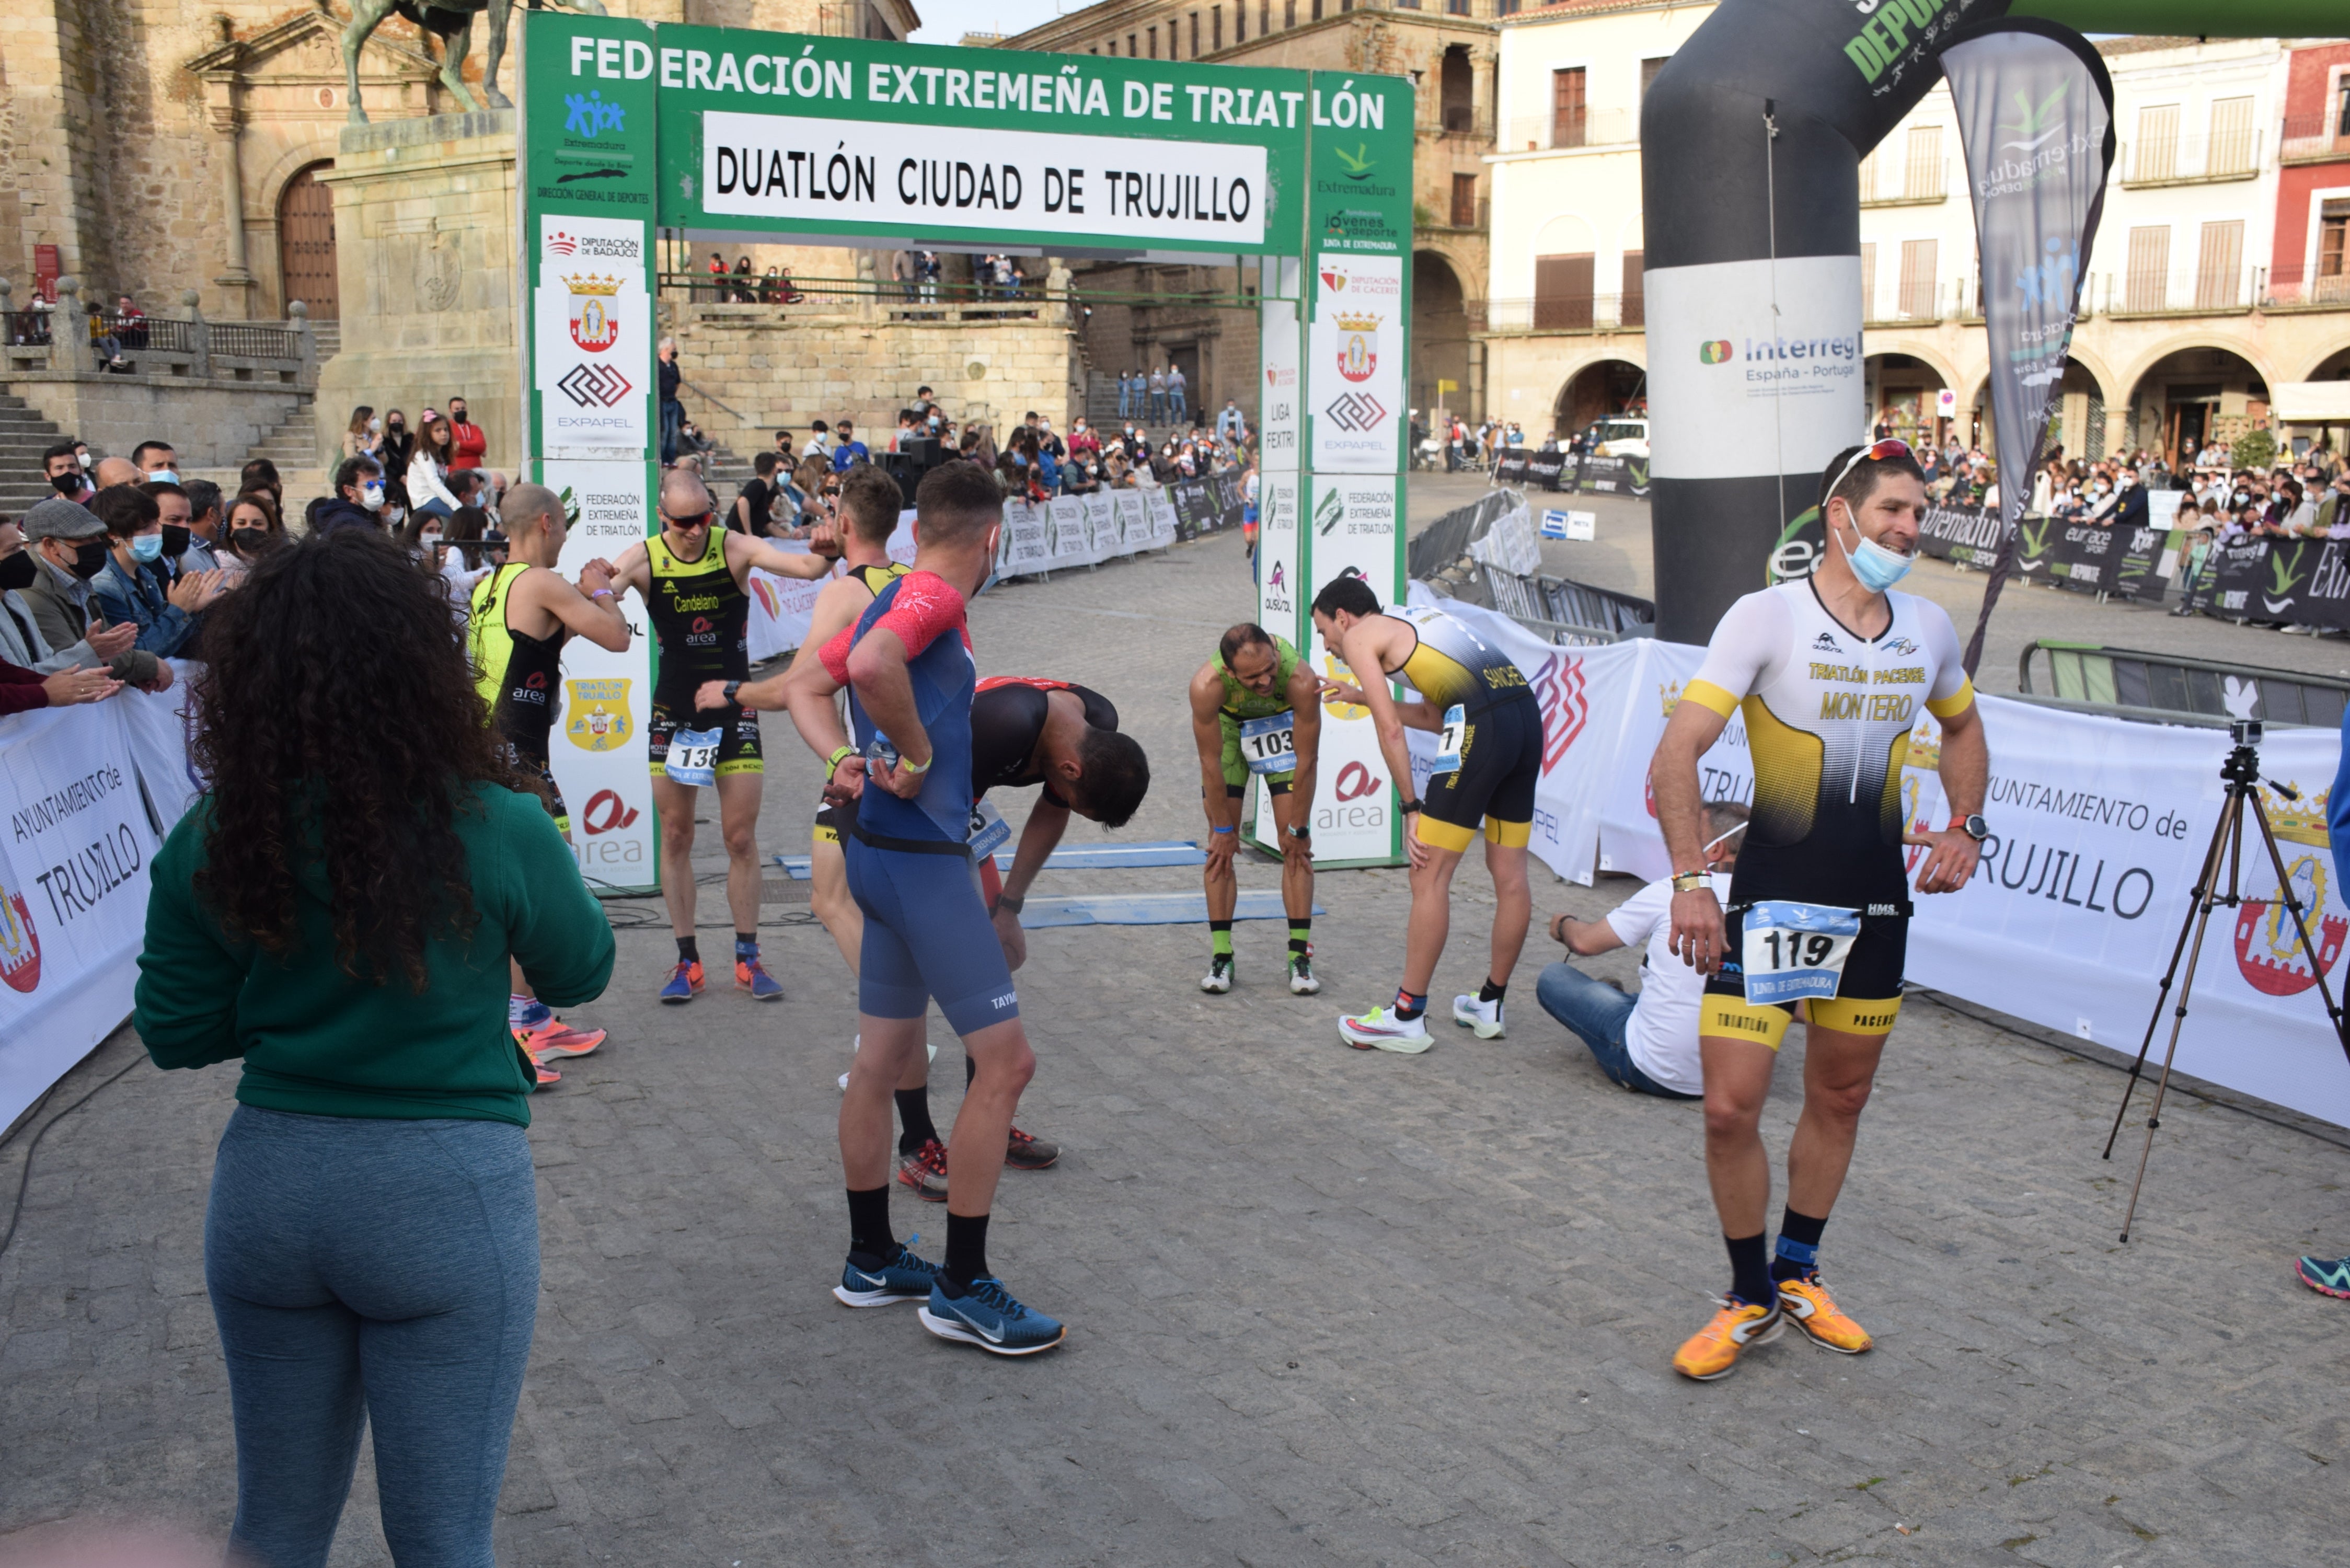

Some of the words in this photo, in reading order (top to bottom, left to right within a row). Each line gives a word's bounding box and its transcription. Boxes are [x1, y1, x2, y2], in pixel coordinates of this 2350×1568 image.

[571, 36, 852, 99] FEDERACIÓN
[868, 63, 1110, 117] EXTREMEÑA
[1123, 80, 1173, 121] DE
[1185, 80, 1385, 131] TRIATLÓN
[563, 139, 626, 151] Extremadura
[717, 141, 876, 203] DUATLÓN
[898, 158, 1022, 210] CIUDAD
[1045, 167, 1085, 215] DE
[1105, 171, 1251, 223] TRUJILLO
[1317, 180, 1396, 197] Extremadura
[1324, 210, 1385, 228] jóvenes
[582, 237, 639, 248] DIPUTACIÓN
[594, 247, 638, 258] BADAJOZ
[1352, 275, 1399, 285] DIPUTACIÓN
[1745, 336, 1854, 361] Interreg
[1746, 367, 1800, 383] España
[1813, 363, 1854, 378] Portugal
[1272, 403, 1290, 421] LIGA
[558, 418, 634, 429] EXPAPEL
[1266, 431, 1294, 448] FEXTRI
[1325, 441, 1387, 451] EXPAPEL
[586, 492, 640, 505] FEDERACIÓN
[1349, 491, 1393, 504] FEDERACIÓN
[588, 508, 639, 521] EXTREMEÑA
[1350, 506, 1392, 519] EXTREMEÑA
[586, 525, 598, 536] DE
[601, 523, 641, 536] TRIATLÓN
[1348, 524, 1357, 535] DE
[1359, 522, 1393, 535] TRIATLÓN
[674, 593, 719, 613] Candelario
[686, 633, 716, 643] area
[1809, 662, 1868, 684] TRIATLÓN
[1873, 667, 1925, 685] PACENSE
[575, 680, 623, 690] TRIATLÓN
[513, 687, 545, 703] area
[578, 691, 622, 700] TRUJILLO
[1819, 691, 1912, 722] MONTERO
[1252, 730, 1294, 758] 103
[681, 746, 719, 768] 138
[11, 769, 107, 844] AYUNTAMIENTO
[107, 763, 122, 789] de
[1988, 776, 2150, 832] UNTAMIENTO
[2156, 809, 2187, 840] de
[1318, 806, 1383, 829] area
[571, 839, 642, 864] area
[1972, 833, 2155, 920] RUJILLO
[1868, 903, 1895, 914] HMS
[1764, 930, 1834, 970] 119
[1752, 982, 1776, 996] JUNTA
[1778, 982, 1785, 992] DE
[1787, 977, 1832, 991] EXTREMADURA
[991, 991, 1017, 1009] TAYM
[1718, 1012, 1769, 1034] TRIATLÓN
